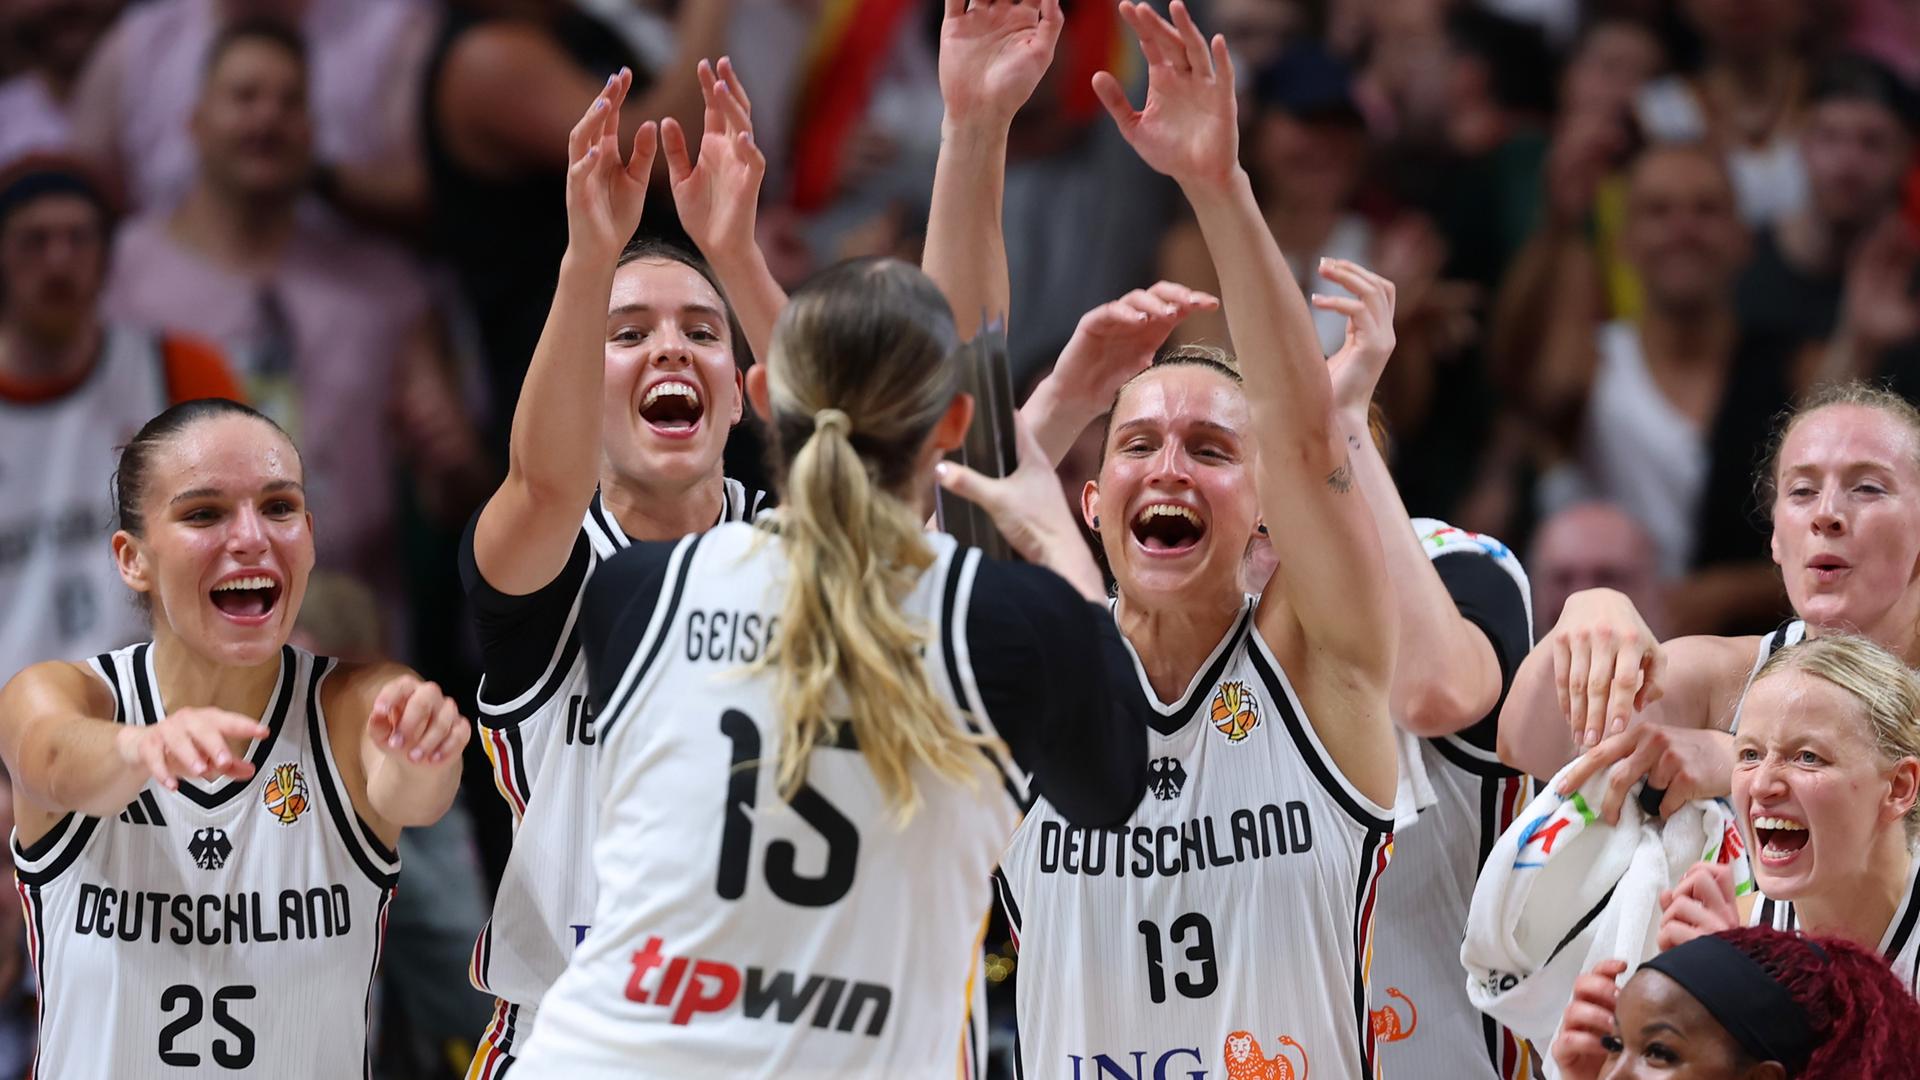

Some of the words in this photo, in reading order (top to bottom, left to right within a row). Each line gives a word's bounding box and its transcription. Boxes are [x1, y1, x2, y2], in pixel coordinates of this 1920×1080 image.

[715, 707, 861, 908] 15
[1040, 801, 1313, 878] DEUTSCHLAND
[75, 883, 351, 946] DEUTSCHLAND
[624, 935, 892, 1037] tipwin
[1138, 912, 1219, 1004] 13
[158, 984, 257, 1070] 25
[1067, 1047, 1209, 1080] ING
